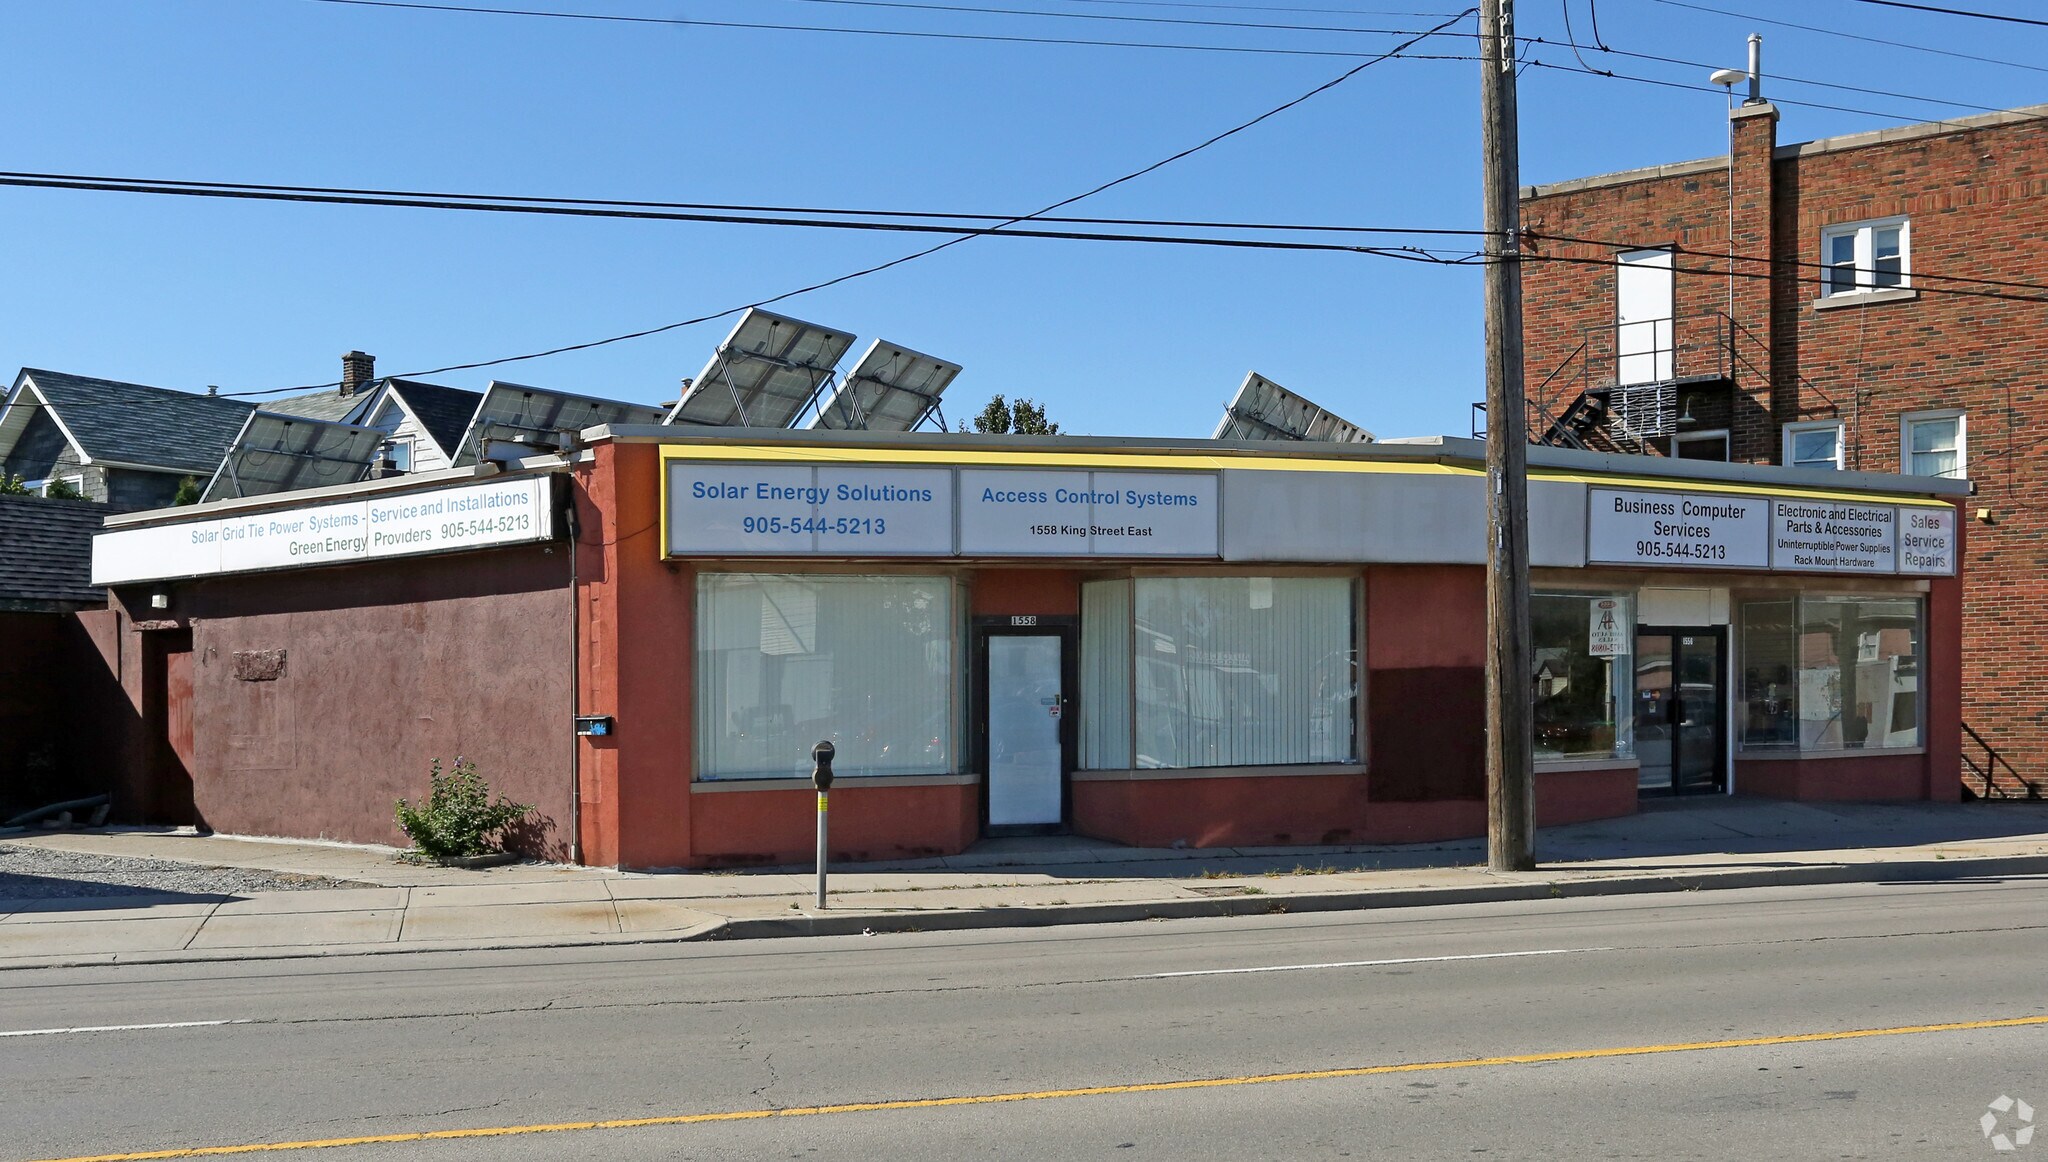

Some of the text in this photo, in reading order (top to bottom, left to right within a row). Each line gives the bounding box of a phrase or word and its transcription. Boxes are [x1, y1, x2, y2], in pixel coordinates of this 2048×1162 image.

[692, 481, 932, 504] Solar Energy Solutions
[982, 488, 1198, 508] Access Control Systems
[1614, 497, 1746, 520] Business Computer
[1778, 504, 1892, 522] Electronic and Electrical
[192, 529, 219, 544] Solar
[222, 524, 244, 541] Grid
[248, 522, 264, 538] Tie
[269, 520, 304, 536] Power
[309, 514, 358, 533] Systems
[372, 505, 417, 524] Service
[420, 499, 442, 516] and
[448, 492, 528, 513] Installations
[743, 516, 886, 534] 905-544-5213
[1911, 514, 1940, 529] Sales
[290, 514, 530, 556] Green Energy Providers 905-544-5213
[1030, 526, 1152, 537] 1558 King Street East
[1654, 520, 1710, 538] Services
[1787, 520, 1882, 538] Parts & Accessories
[1778, 538, 1890, 554] Uninterruptible Power Supplies
[1905, 532, 1944, 548] Service
[1636, 540, 1726, 560] 905-544-5213
[1794, 554, 1874, 568] Rack Mount Hardware
[1905, 552, 1945, 568] Repairs
[1012, 616, 1036, 624] 1558
